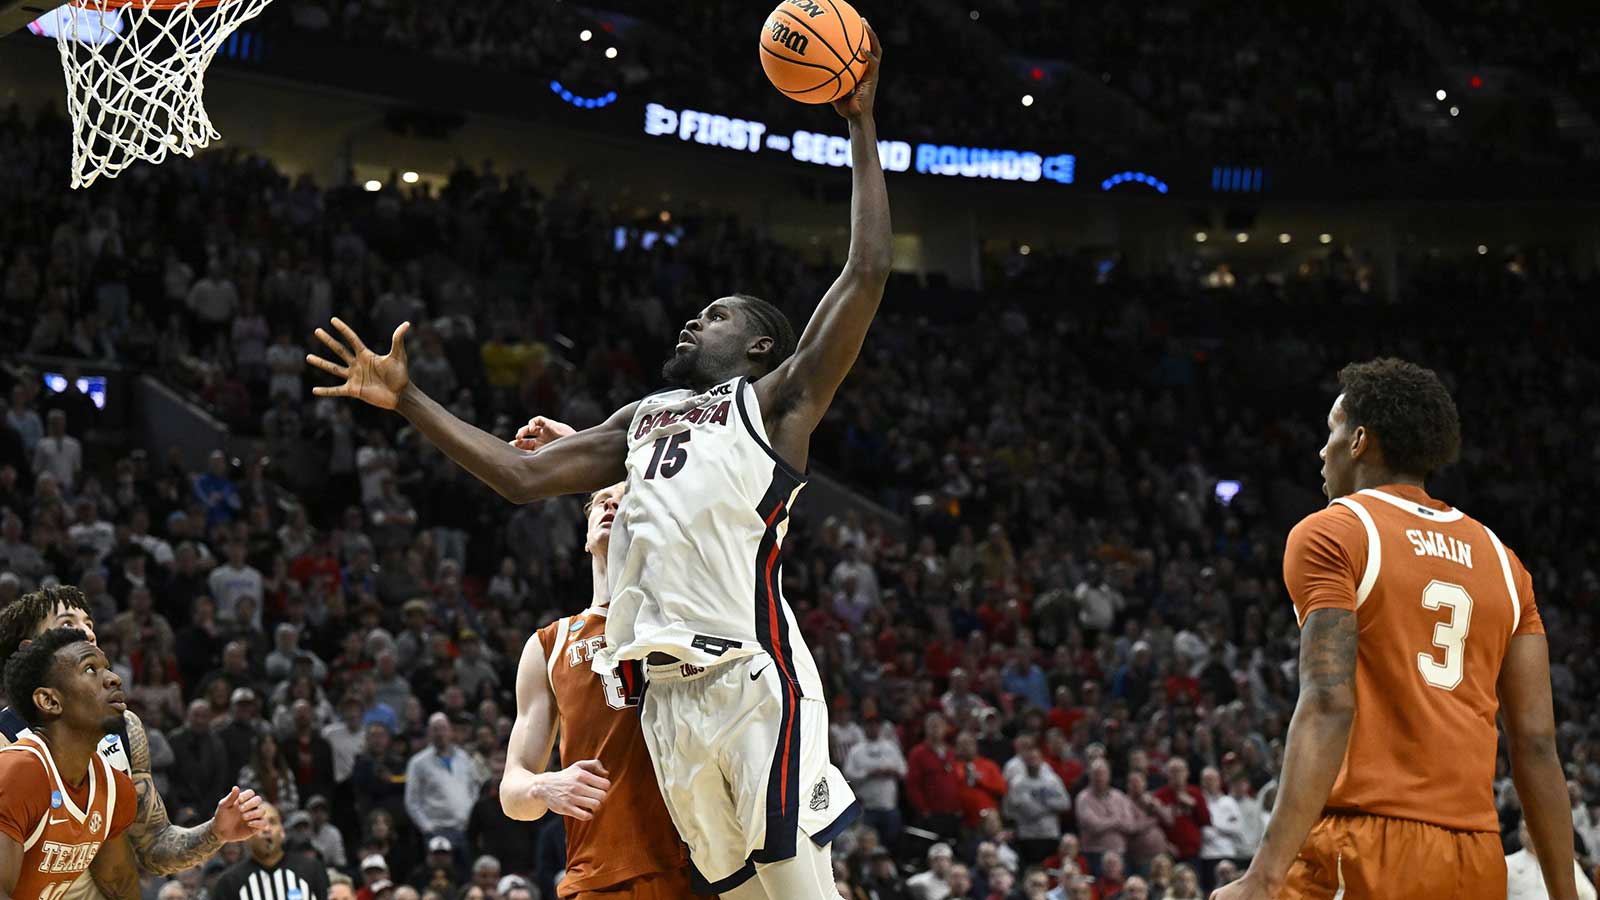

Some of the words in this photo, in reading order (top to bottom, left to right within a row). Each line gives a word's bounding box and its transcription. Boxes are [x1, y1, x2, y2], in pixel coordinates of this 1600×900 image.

[679, 109, 766, 153] FIRST
[791, 130, 912, 173] SECND
[915, 142, 1043, 183] ROUNDS
[709, 384, 733, 397] WCC
[644, 429, 691, 480] 15
[1406, 529, 1473, 569] SWAIN
[1417, 579, 1474, 691] 3
[102, 743, 120, 757] WCC
[38, 840, 101, 874] TEXAS
